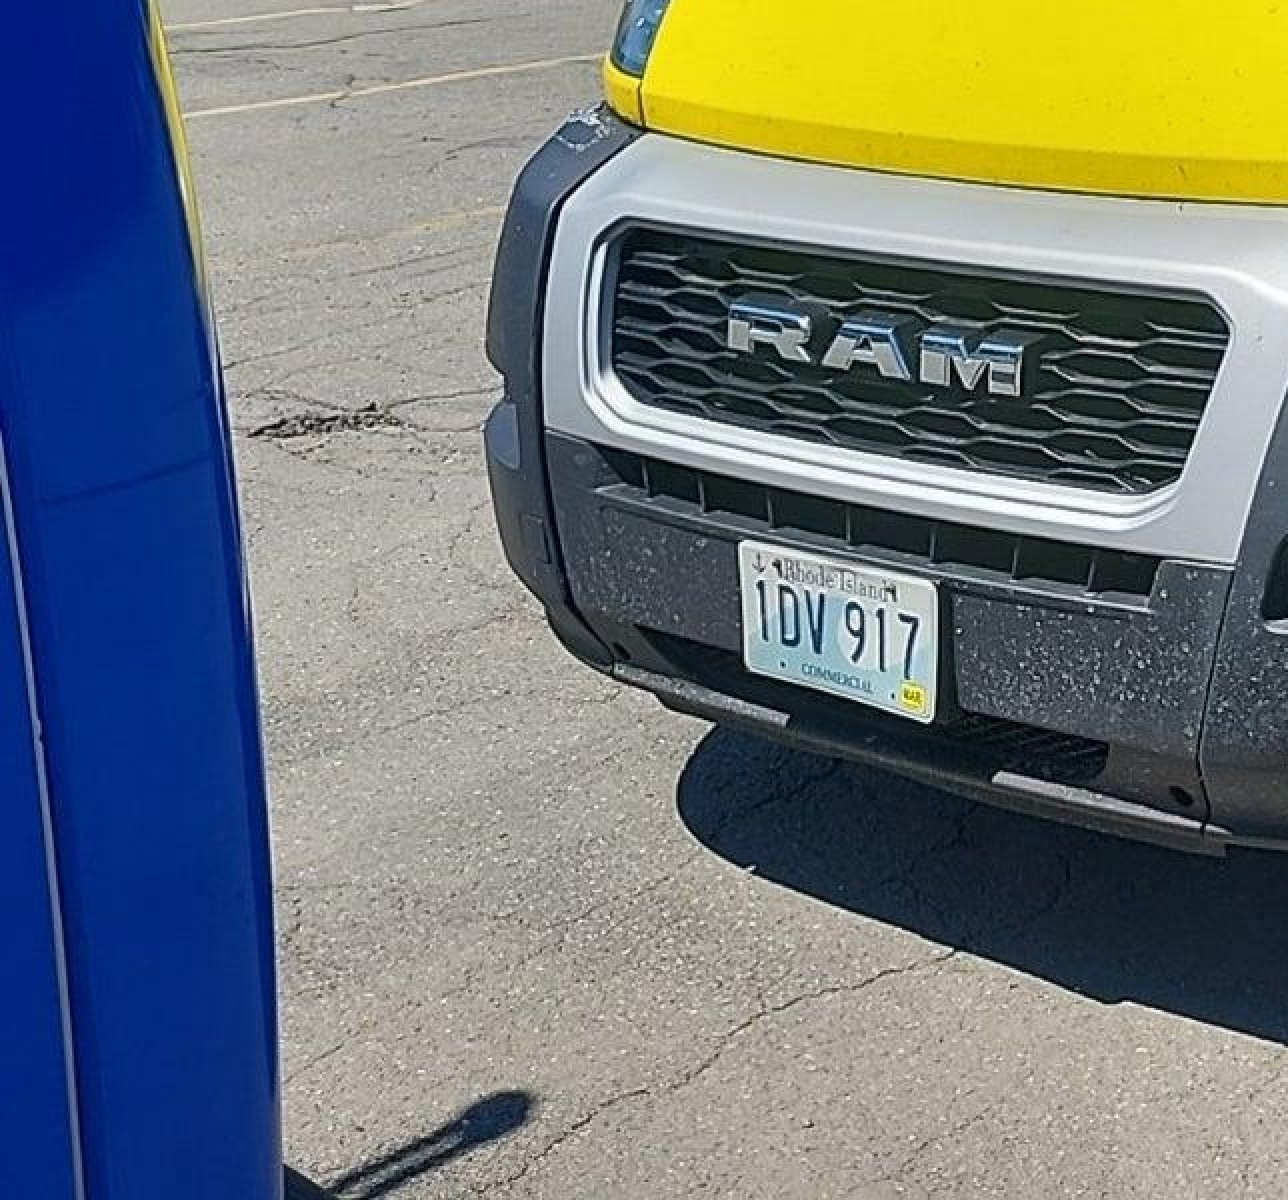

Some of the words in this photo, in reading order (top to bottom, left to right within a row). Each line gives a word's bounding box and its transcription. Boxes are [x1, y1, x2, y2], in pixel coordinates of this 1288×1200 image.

[727, 300, 1024, 398] RAM
[783, 557, 835, 590] Rhode
[838, 570, 890, 602] Island
[756, 579, 826, 655] 1DV
[844, 600, 920, 681] 917
